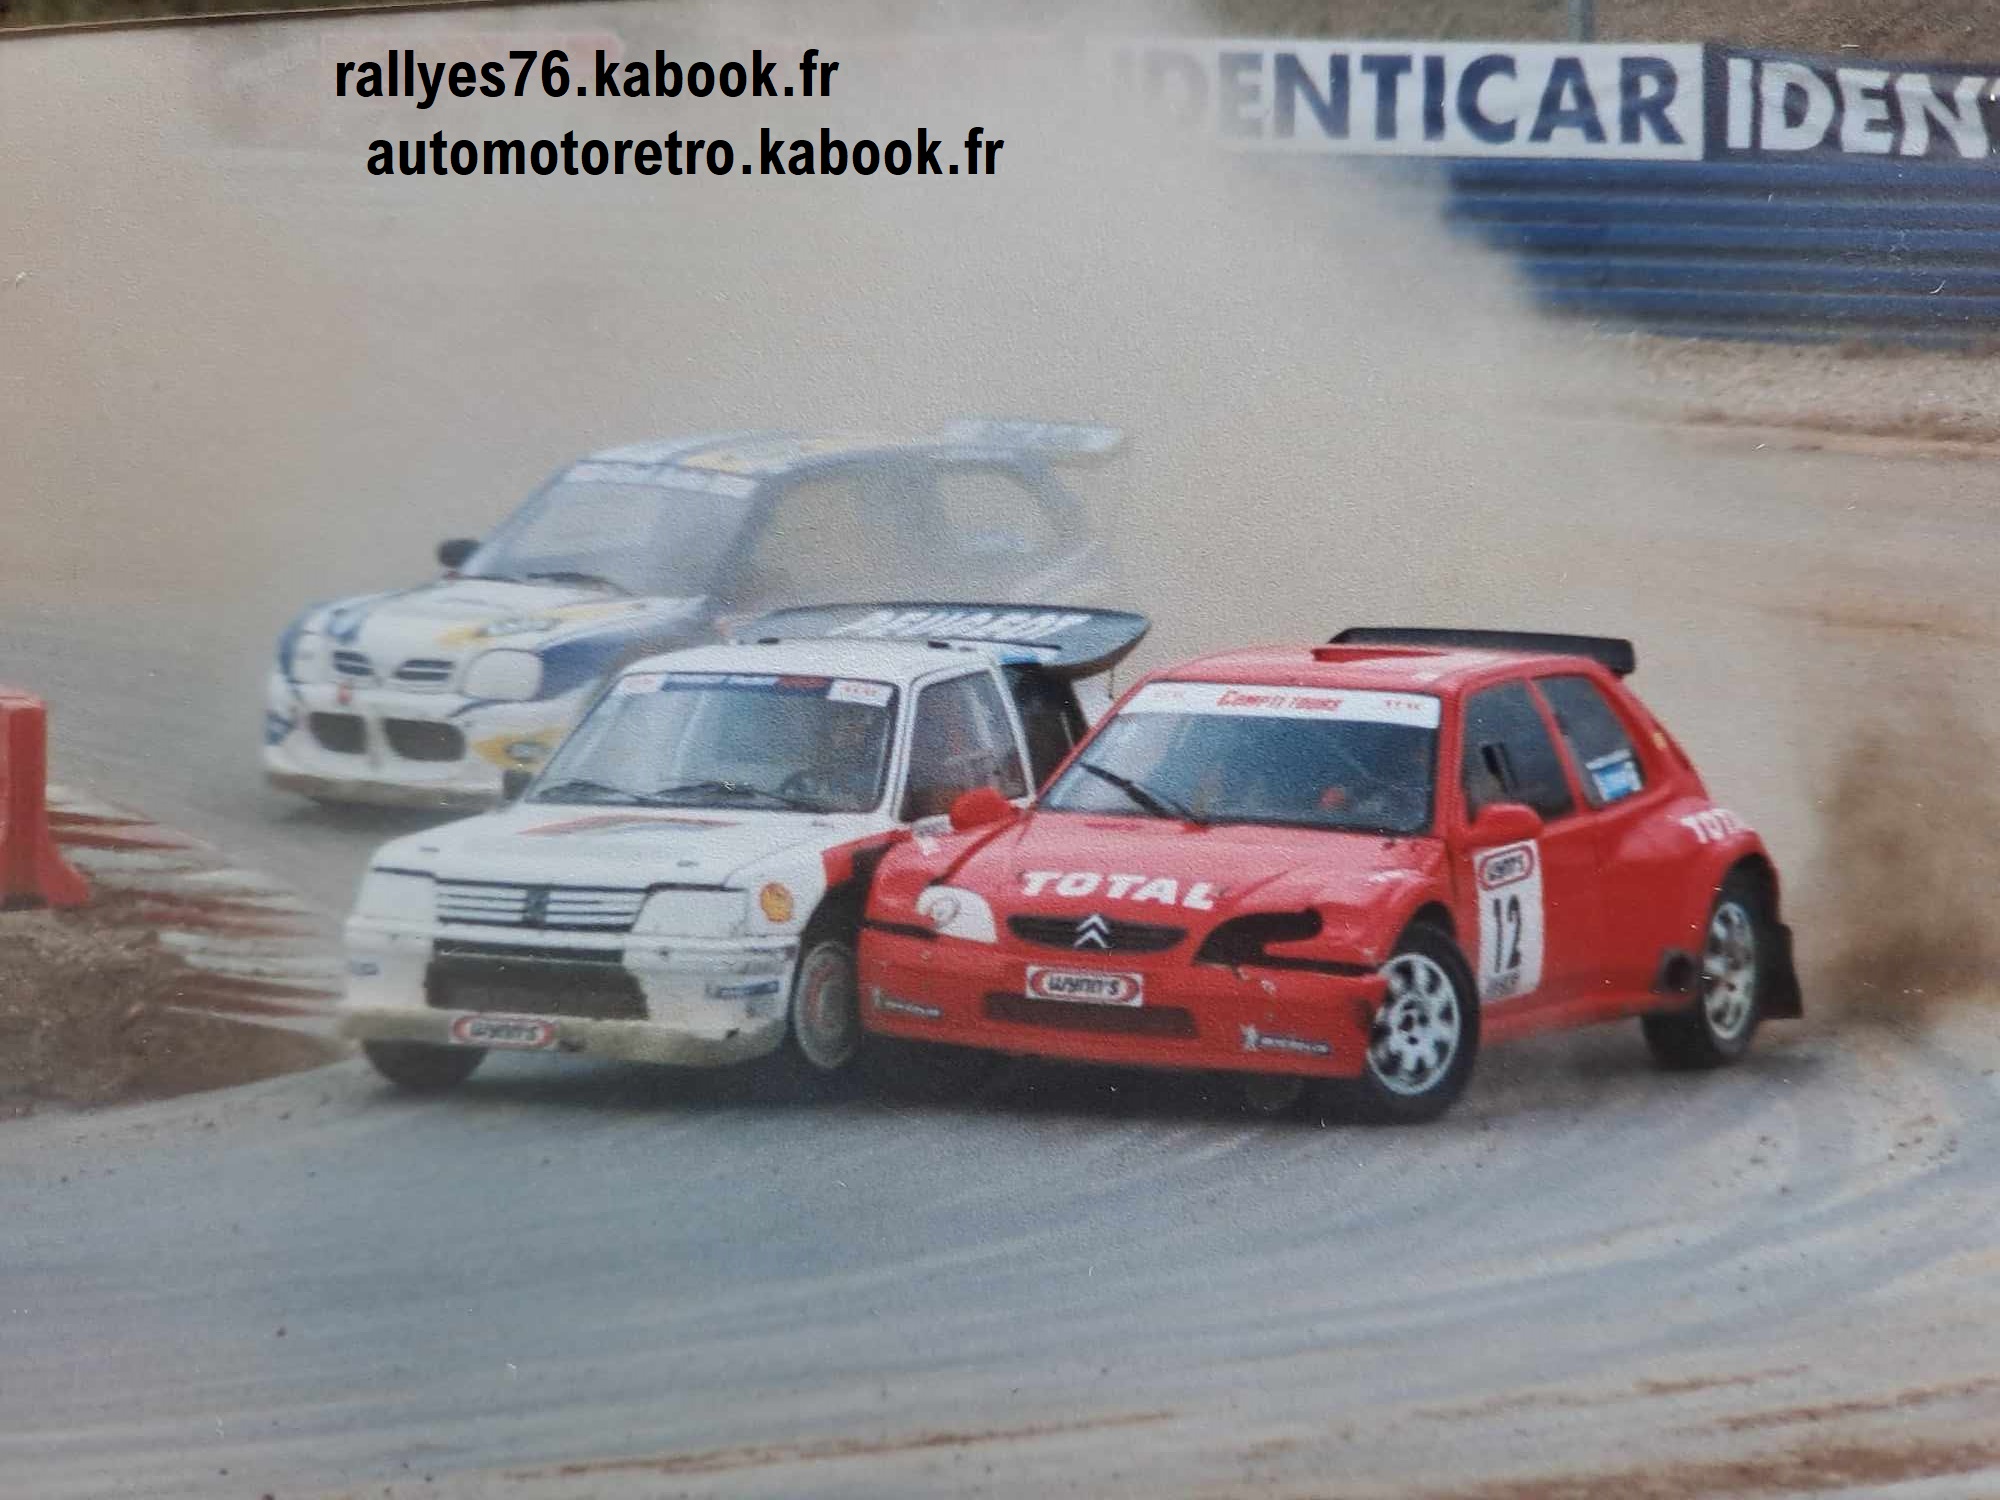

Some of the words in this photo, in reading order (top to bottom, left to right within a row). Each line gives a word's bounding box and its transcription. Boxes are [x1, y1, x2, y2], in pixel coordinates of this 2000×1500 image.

[1727, 57, 2000, 159] IDEN
[1022, 871, 1214, 911] TOTAL
[1493, 894, 1522, 973] 12
